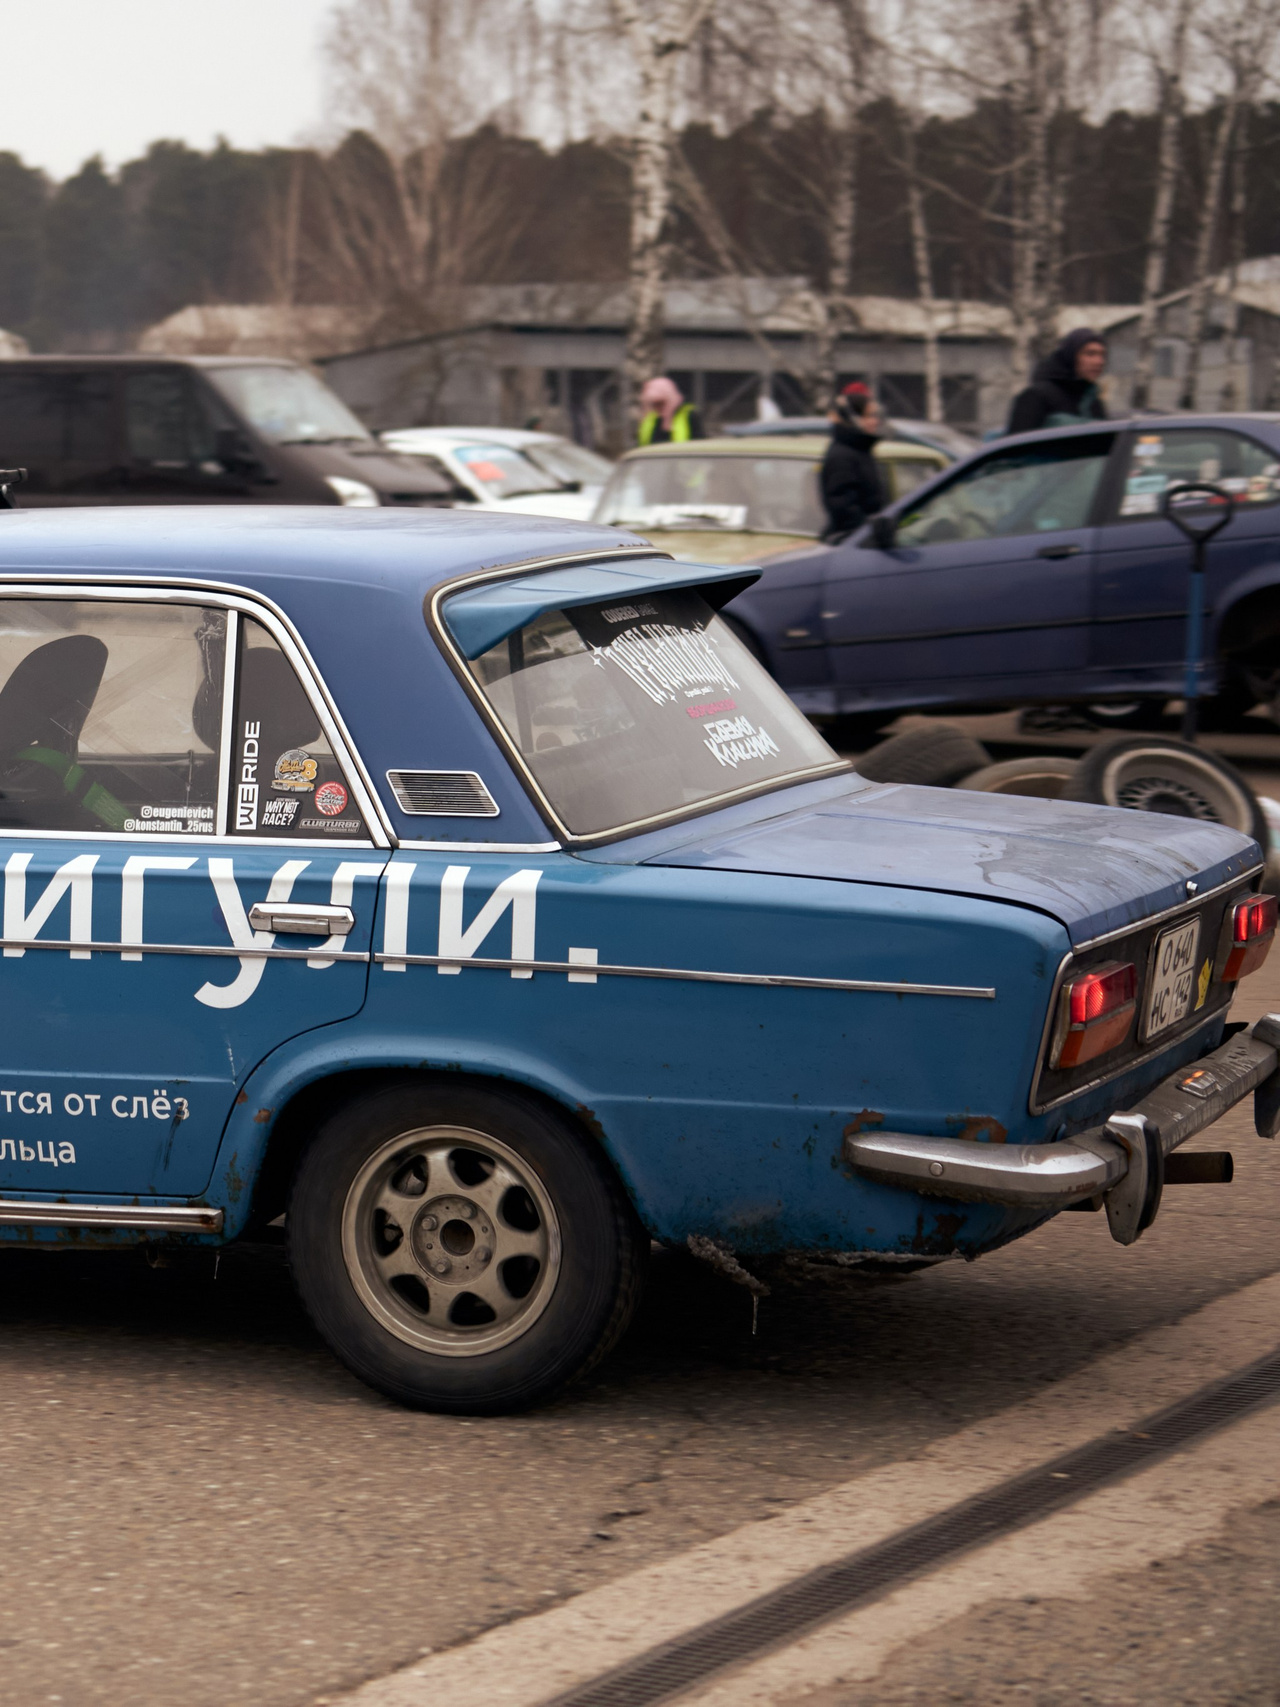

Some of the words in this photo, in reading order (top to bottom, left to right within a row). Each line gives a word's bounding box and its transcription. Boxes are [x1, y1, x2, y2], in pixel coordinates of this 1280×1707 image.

[153, 806, 214, 820] eugenievich
[265, 800, 284, 814] WHY
[136, 819, 214, 832] konstantin_25rus
[261, 813, 295, 826] RACE?
[301, 820, 360, 829] CLUBTURBO
[63, 1092, 101, 1117] от
[111, 1089, 190, 1121] слёз
